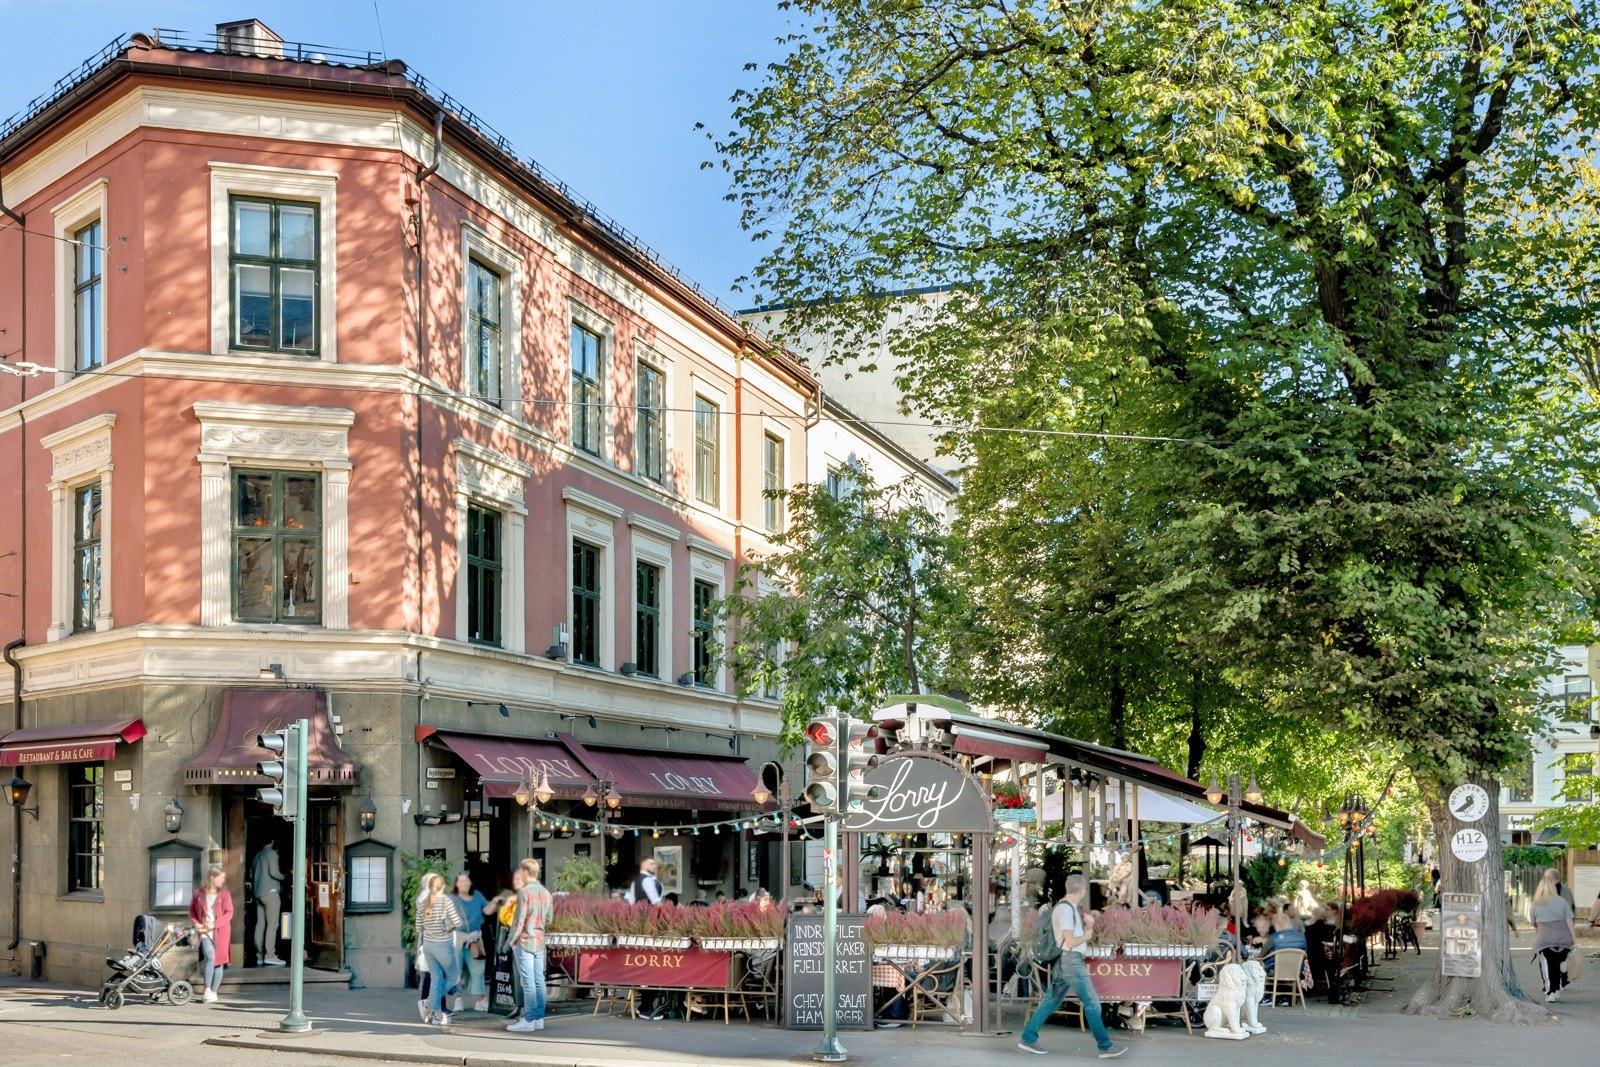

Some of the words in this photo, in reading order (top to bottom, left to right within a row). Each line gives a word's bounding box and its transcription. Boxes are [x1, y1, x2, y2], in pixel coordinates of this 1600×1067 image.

[19, 752, 54, 763] RESTAURANT
[55, 750, 60, 761] &
[61, 750, 72, 760] BAR
[73, 749, 77, 759] &
[78, 748, 93, 759] CAFE
[475, 753, 581, 778] LORRY
[650, 772, 722, 795] LORRY
[846, 759, 966, 828] Lorry
[1456, 832, 1482, 845] H12
[795, 924, 865, 939] INDRFILET
[793, 941, 866, 957] REINSDKAKER
[624, 954, 684, 968] LORRY
[793, 960, 866, 974] FJELLRRET
[1086, 963, 1154, 977] LORRY
[838, 994, 867, 1009] SALAT
[796, 1010, 864, 1025] HAMRGER
